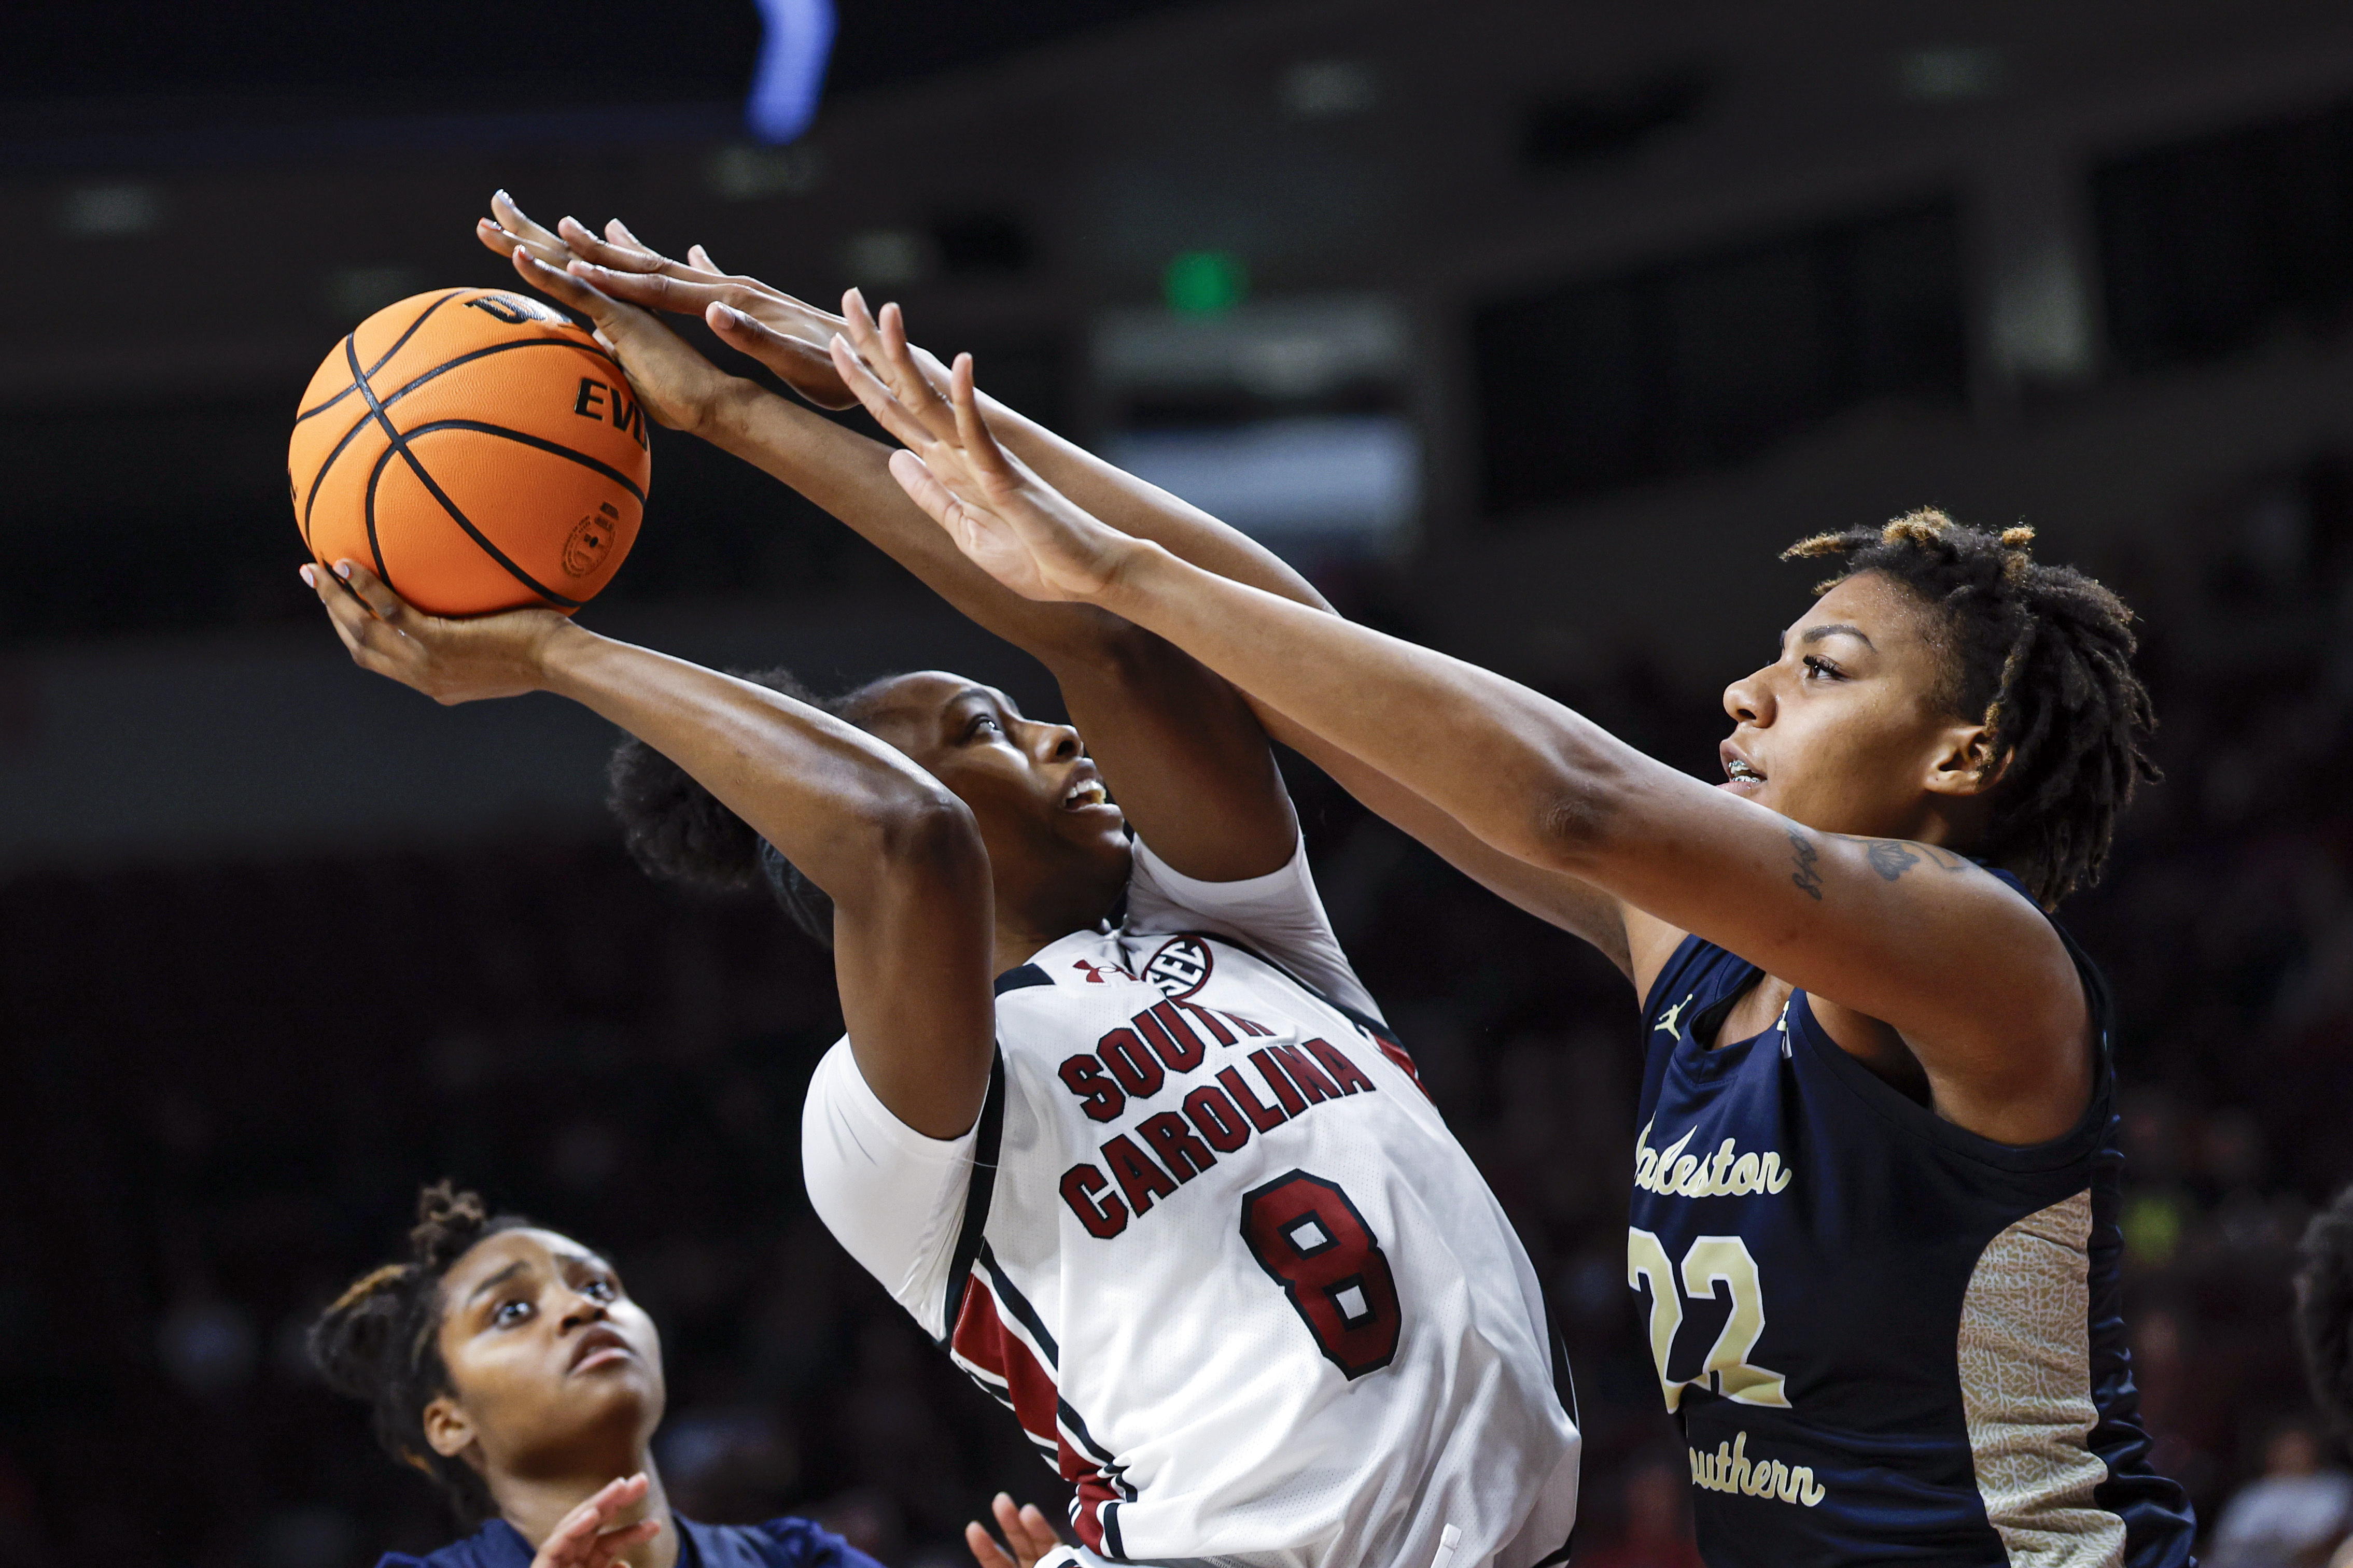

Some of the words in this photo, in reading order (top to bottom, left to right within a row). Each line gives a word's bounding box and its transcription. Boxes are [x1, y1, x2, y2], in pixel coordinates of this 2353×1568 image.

[1145, 940, 1206, 996] SEC
[1059, 1038, 1376, 1239] CAROLINA
[1240, 1168, 1402, 1381] 8
[1628, 1225, 1792, 1414] 22
